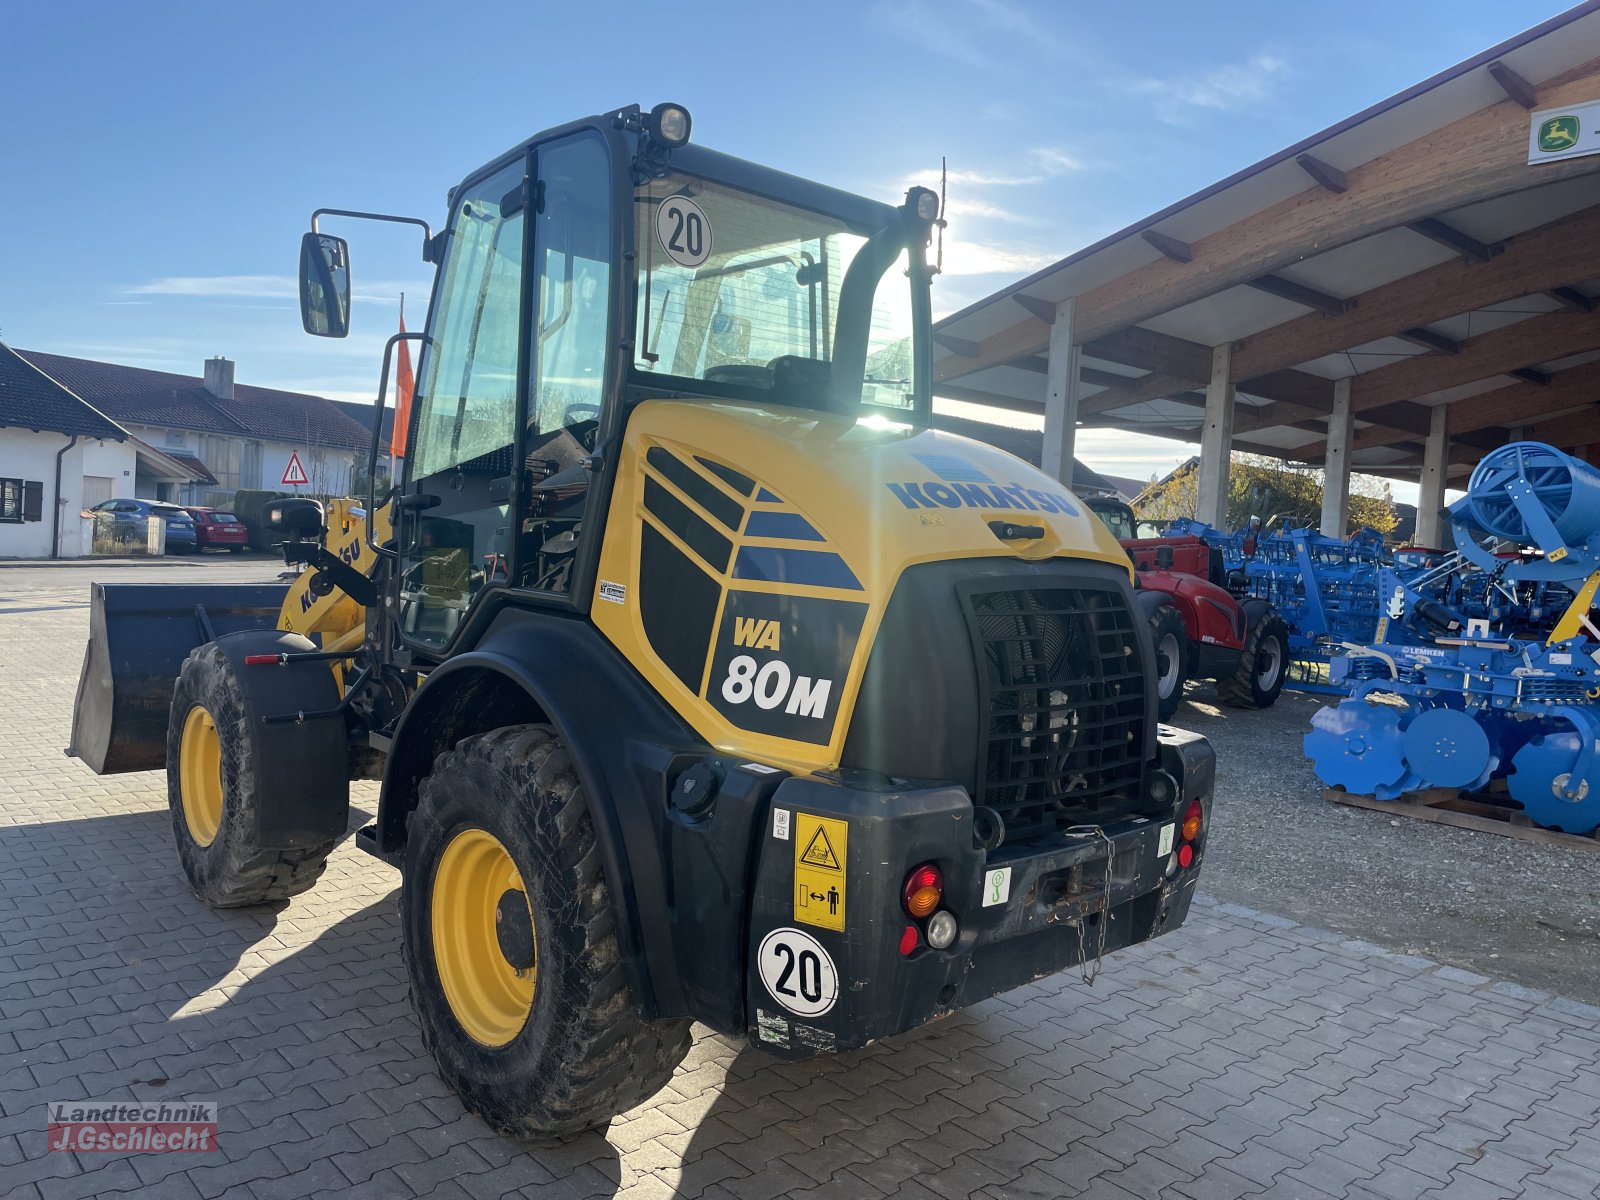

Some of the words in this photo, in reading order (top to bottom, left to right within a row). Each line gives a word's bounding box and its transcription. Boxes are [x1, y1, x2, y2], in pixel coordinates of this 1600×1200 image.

[668, 207, 702, 256] 20
[886, 482, 1080, 517] KOMATSU
[733, 616, 780, 651] WA
[1410, 647, 1445, 657] LEMKEN
[774, 943, 821, 1003] 20
